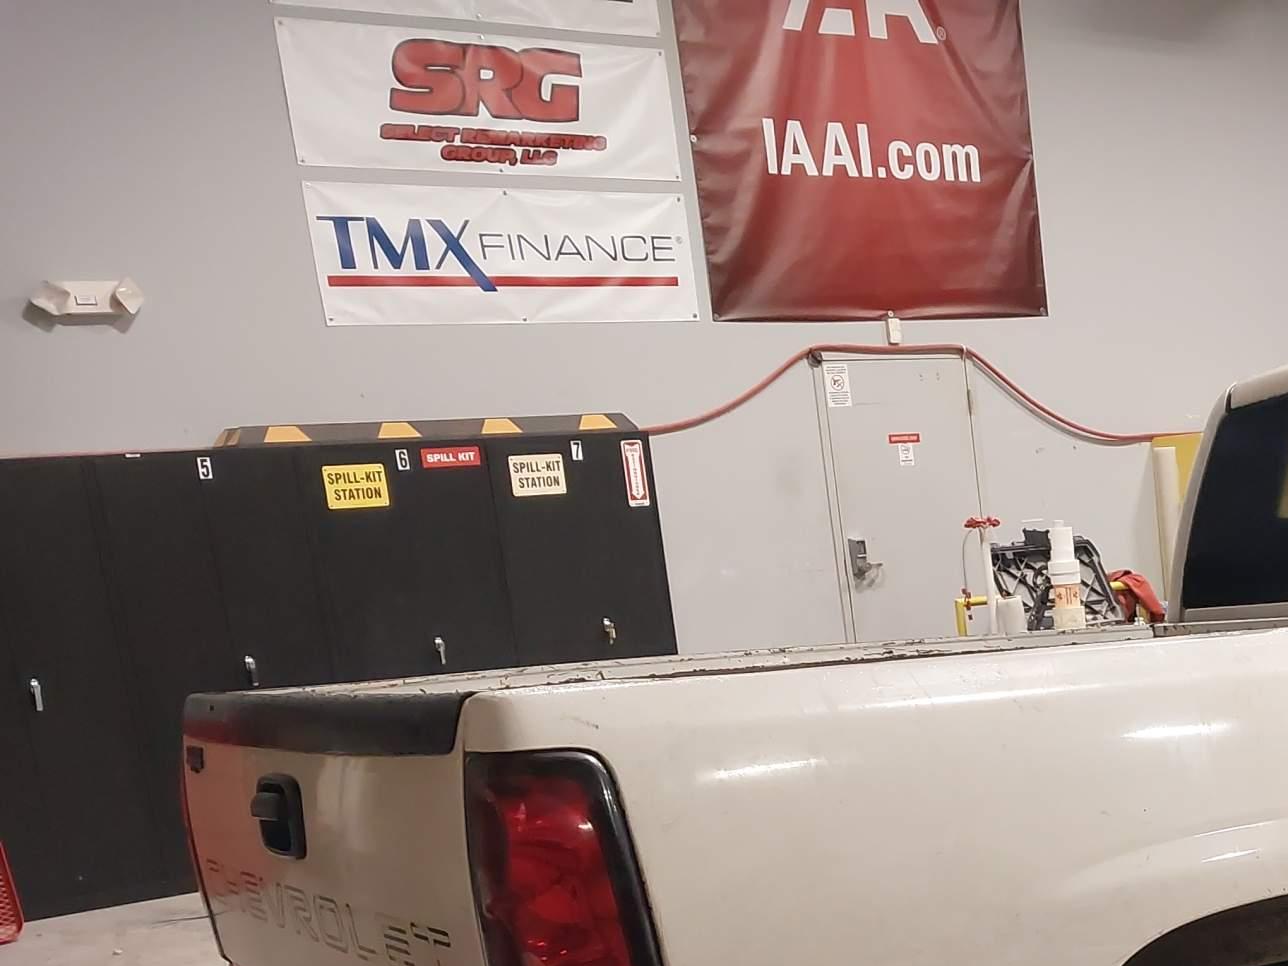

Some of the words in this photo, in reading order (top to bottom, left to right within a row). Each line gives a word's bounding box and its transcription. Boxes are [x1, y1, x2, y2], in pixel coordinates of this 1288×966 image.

[390, 38, 583, 123] SRG
[761, 117, 982, 183] IAAI.com
[316, 215, 498, 292] TMX
[478, 233, 677, 263] FINANCE
[426, 452, 456, 463] SPILL
[458, 451, 475, 462] KIT
[573, 442, 580, 459] 7
[199, 458, 210, 478] 5
[399, 450, 408, 469] 6
[512, 460, 561, 474] SPILL-KIT
[327, 470, 383, 485] SPILL-KIT
[518, 475, 560, 489] STATION
[333, 486, 382, 501] STATION
